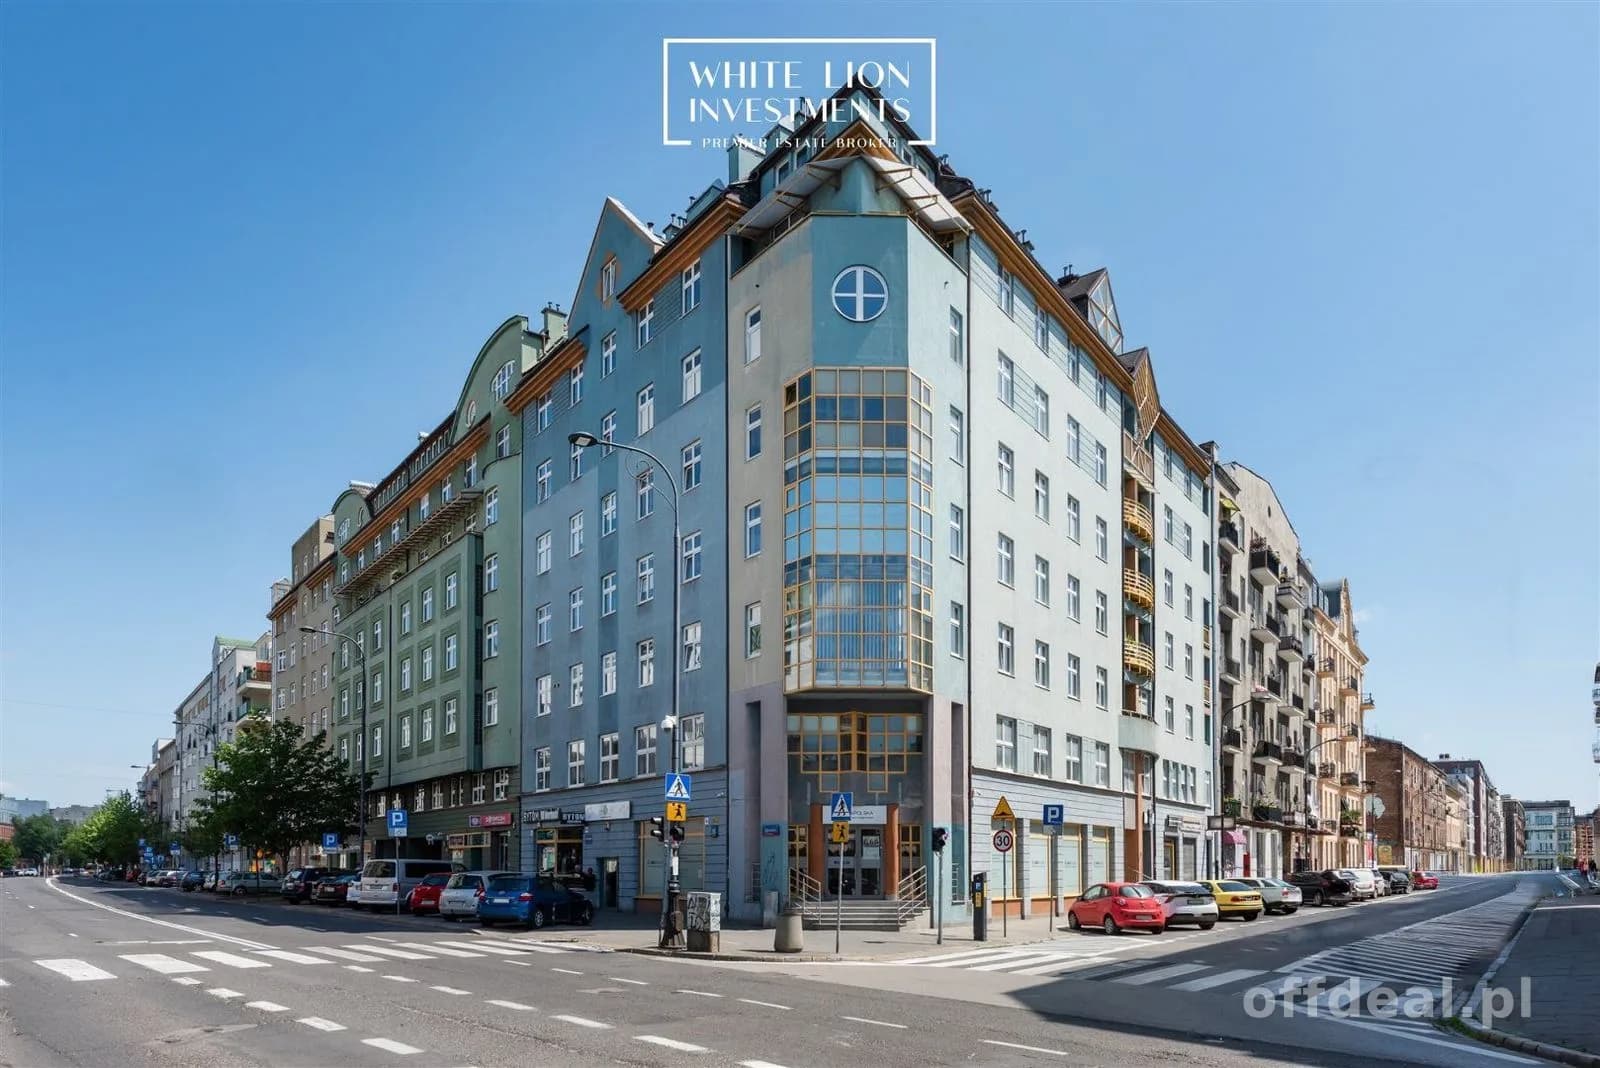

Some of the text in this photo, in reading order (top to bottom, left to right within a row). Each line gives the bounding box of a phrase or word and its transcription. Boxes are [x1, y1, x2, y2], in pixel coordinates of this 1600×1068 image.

[391, 812, 403, 826] P
[1047, 806, 1059, 823] P
[228, 835, 236, 844] P
[326, 834, 335, 846] P
[996, 835, 1010, 847] 30
